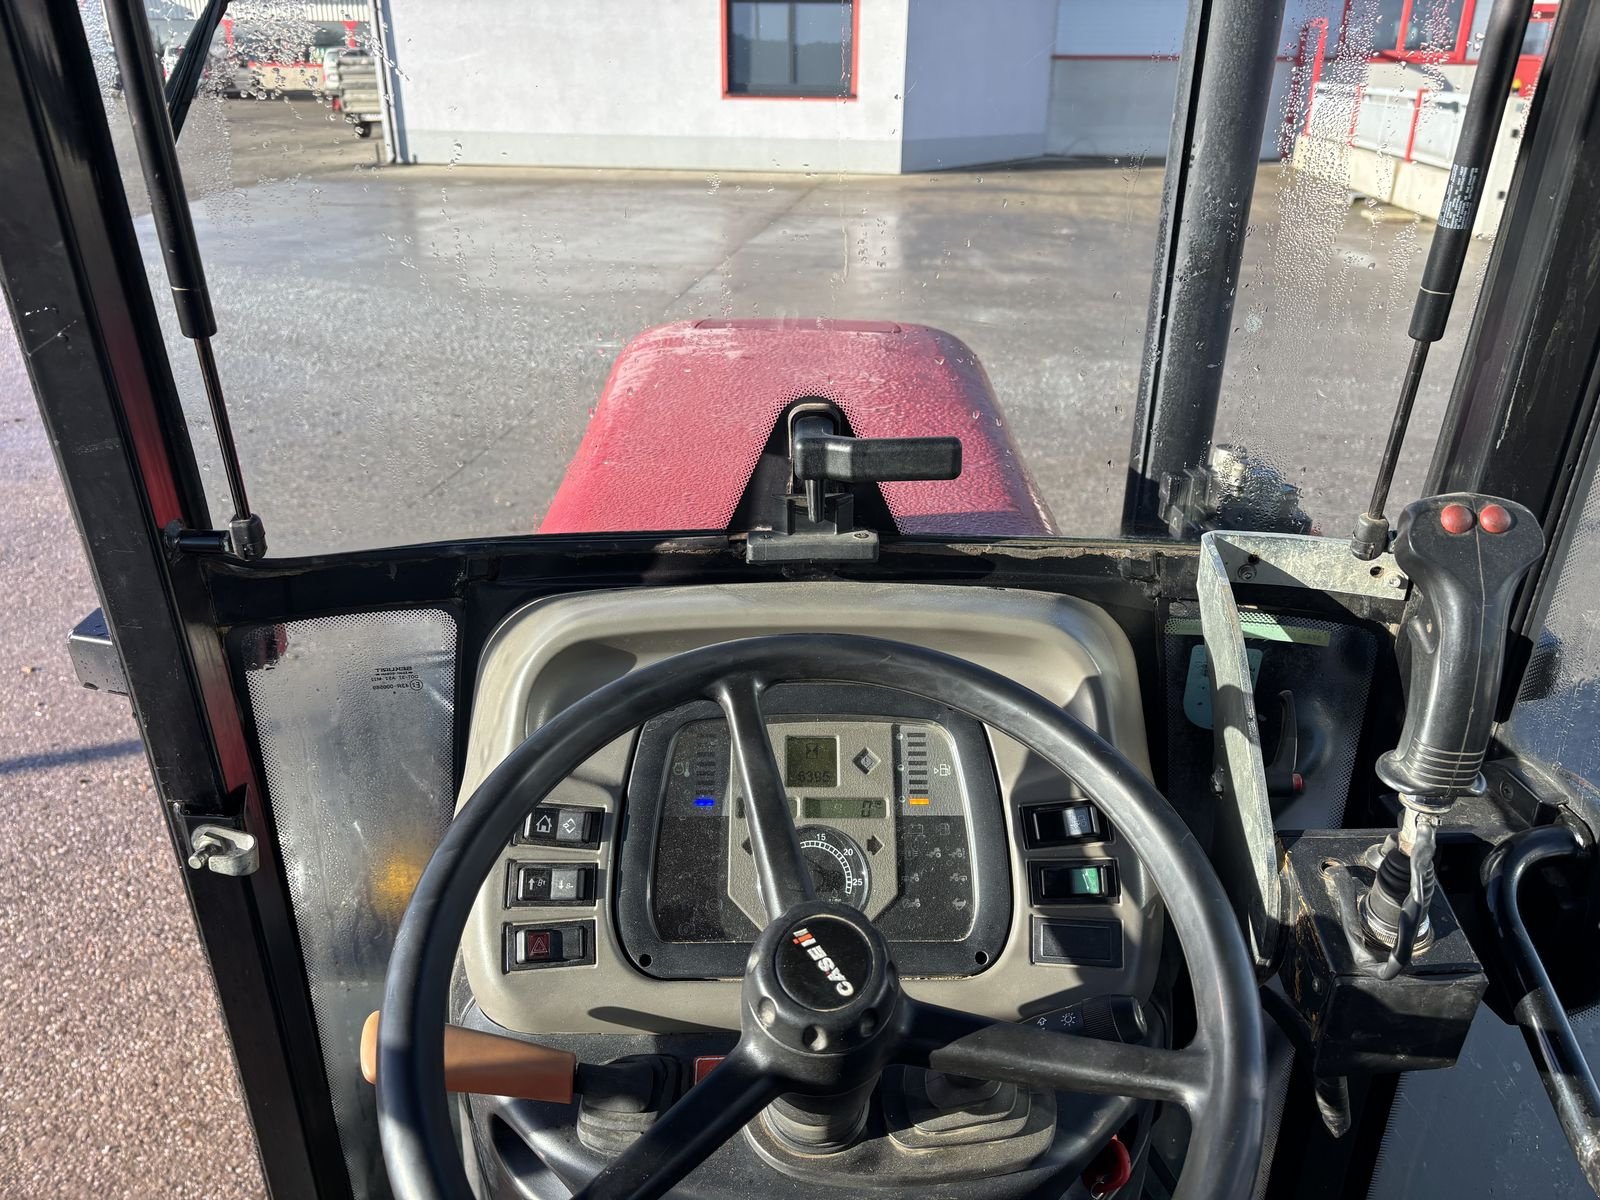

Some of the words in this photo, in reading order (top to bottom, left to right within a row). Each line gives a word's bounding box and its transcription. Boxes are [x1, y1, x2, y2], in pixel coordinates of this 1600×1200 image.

[816, 833, 826, 841] 15
[843, 848, 854, 856] 20
[852, 878, 863, 886] 25
[807, 945, 854, 997] CASE
